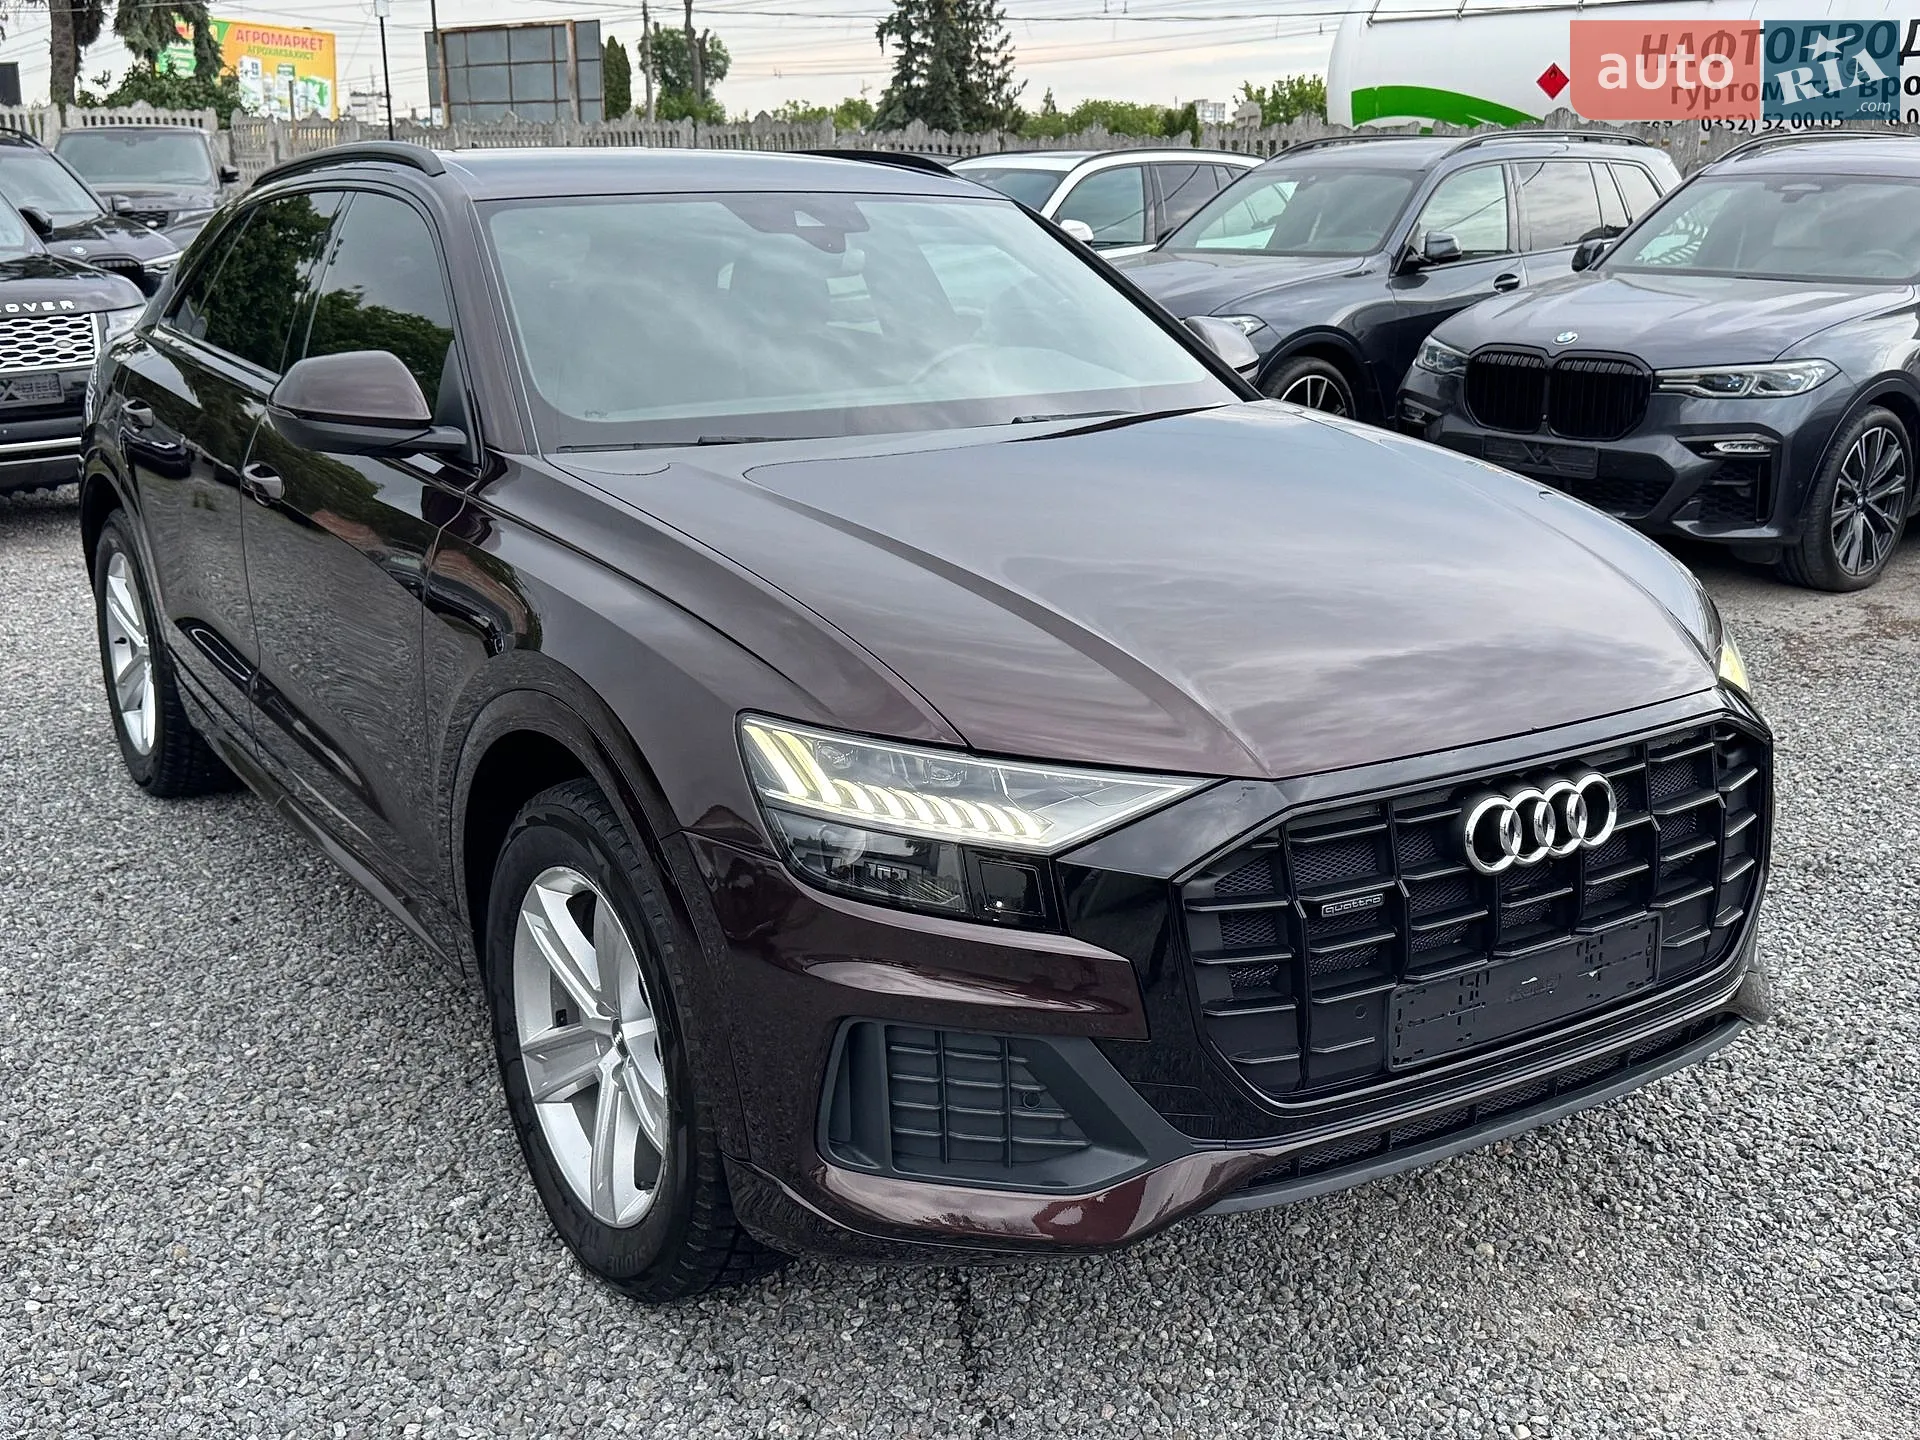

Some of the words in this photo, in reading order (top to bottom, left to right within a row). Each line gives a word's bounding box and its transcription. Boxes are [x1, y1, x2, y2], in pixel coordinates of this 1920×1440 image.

[235, 29, 324, 51] АГРОМАРКЕТ
[0, 300, 75, 313] OVER
[1325, 896, 1381, 914] quattro
